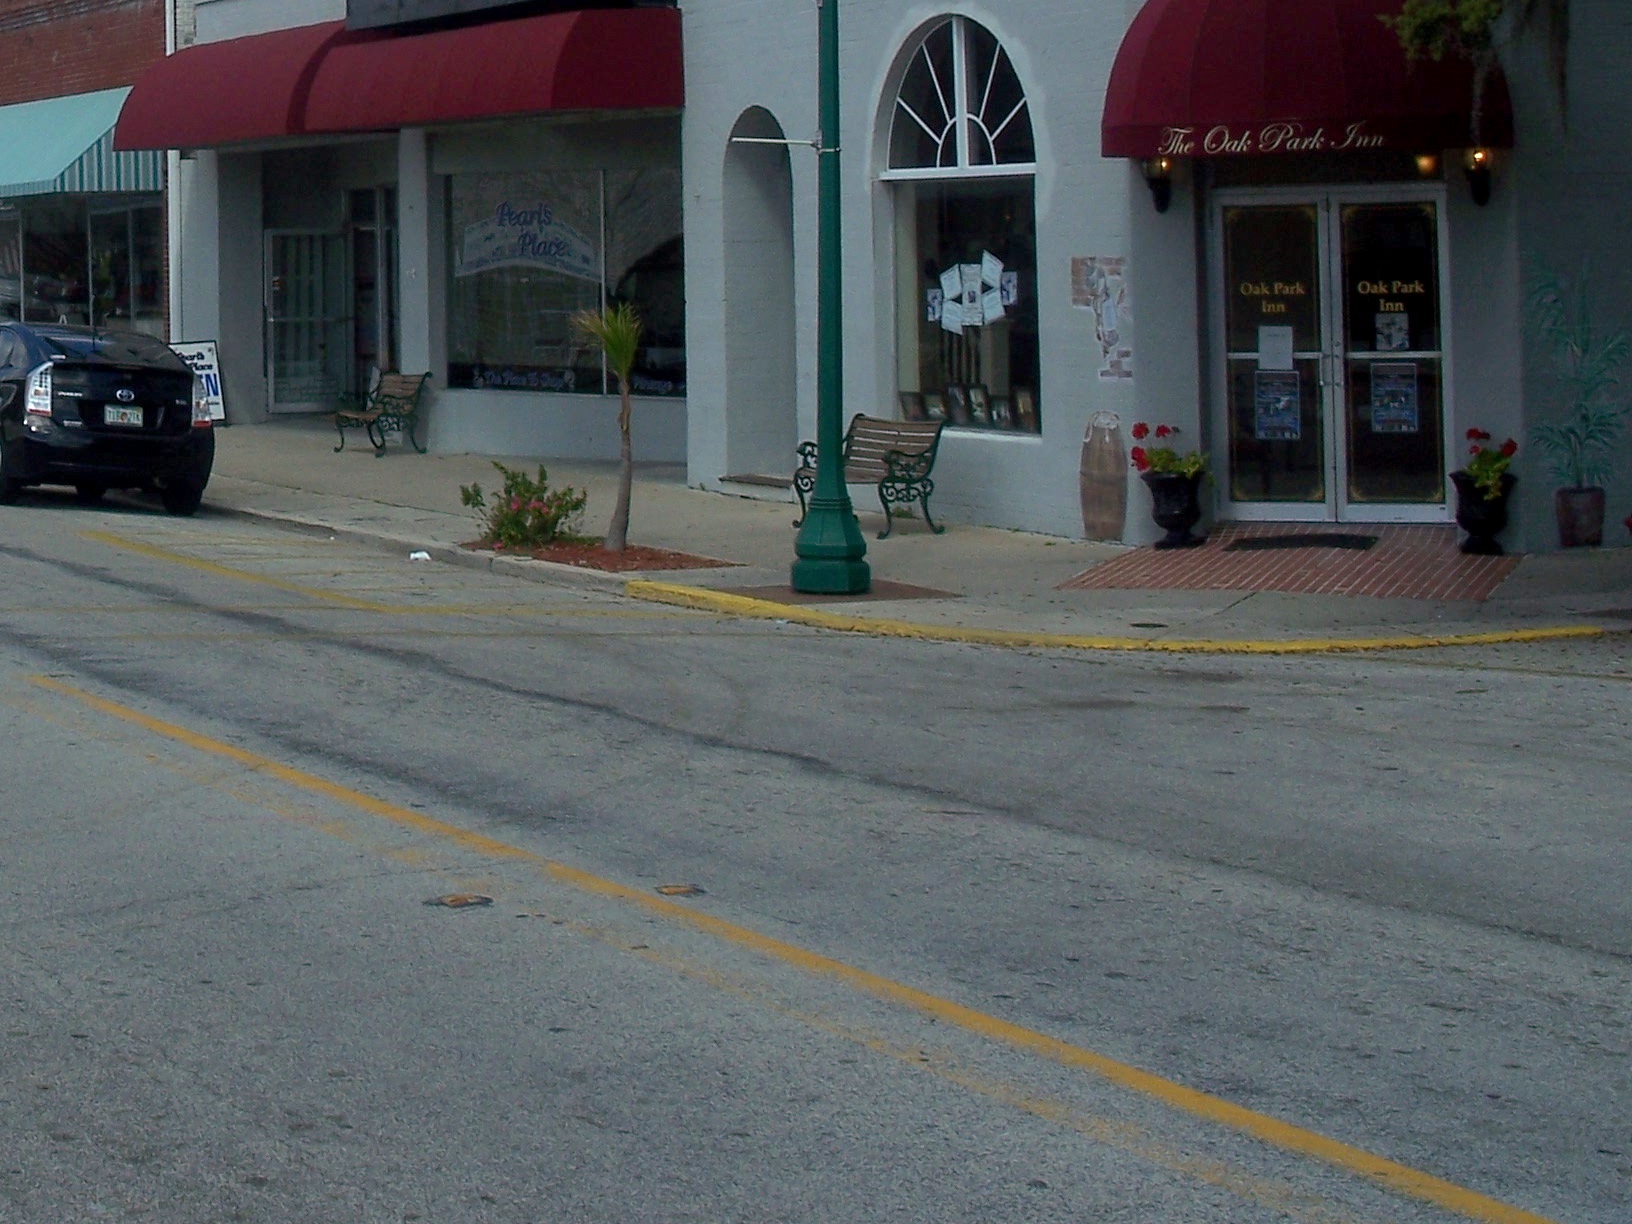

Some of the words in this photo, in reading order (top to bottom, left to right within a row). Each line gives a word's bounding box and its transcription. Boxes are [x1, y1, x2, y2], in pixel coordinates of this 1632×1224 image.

[1158, 127, 1194, 154] The
[1203, 125, 1252, 154] Oak
[1258, 122, 1325, 151] Park
[1330, 120, 1384, 149] Inn
[519, 228, 566, 257] Place
[1240, 283, 1269, 296] Oak
[1274, 282, 1305, 295] Park
[1357, 280, 1388, 294] Oak
[1392, 280, 1425, 294] Park
[1262, 300, 1285, 313] Inn
[1380, 299, 1404, 312] Inn
